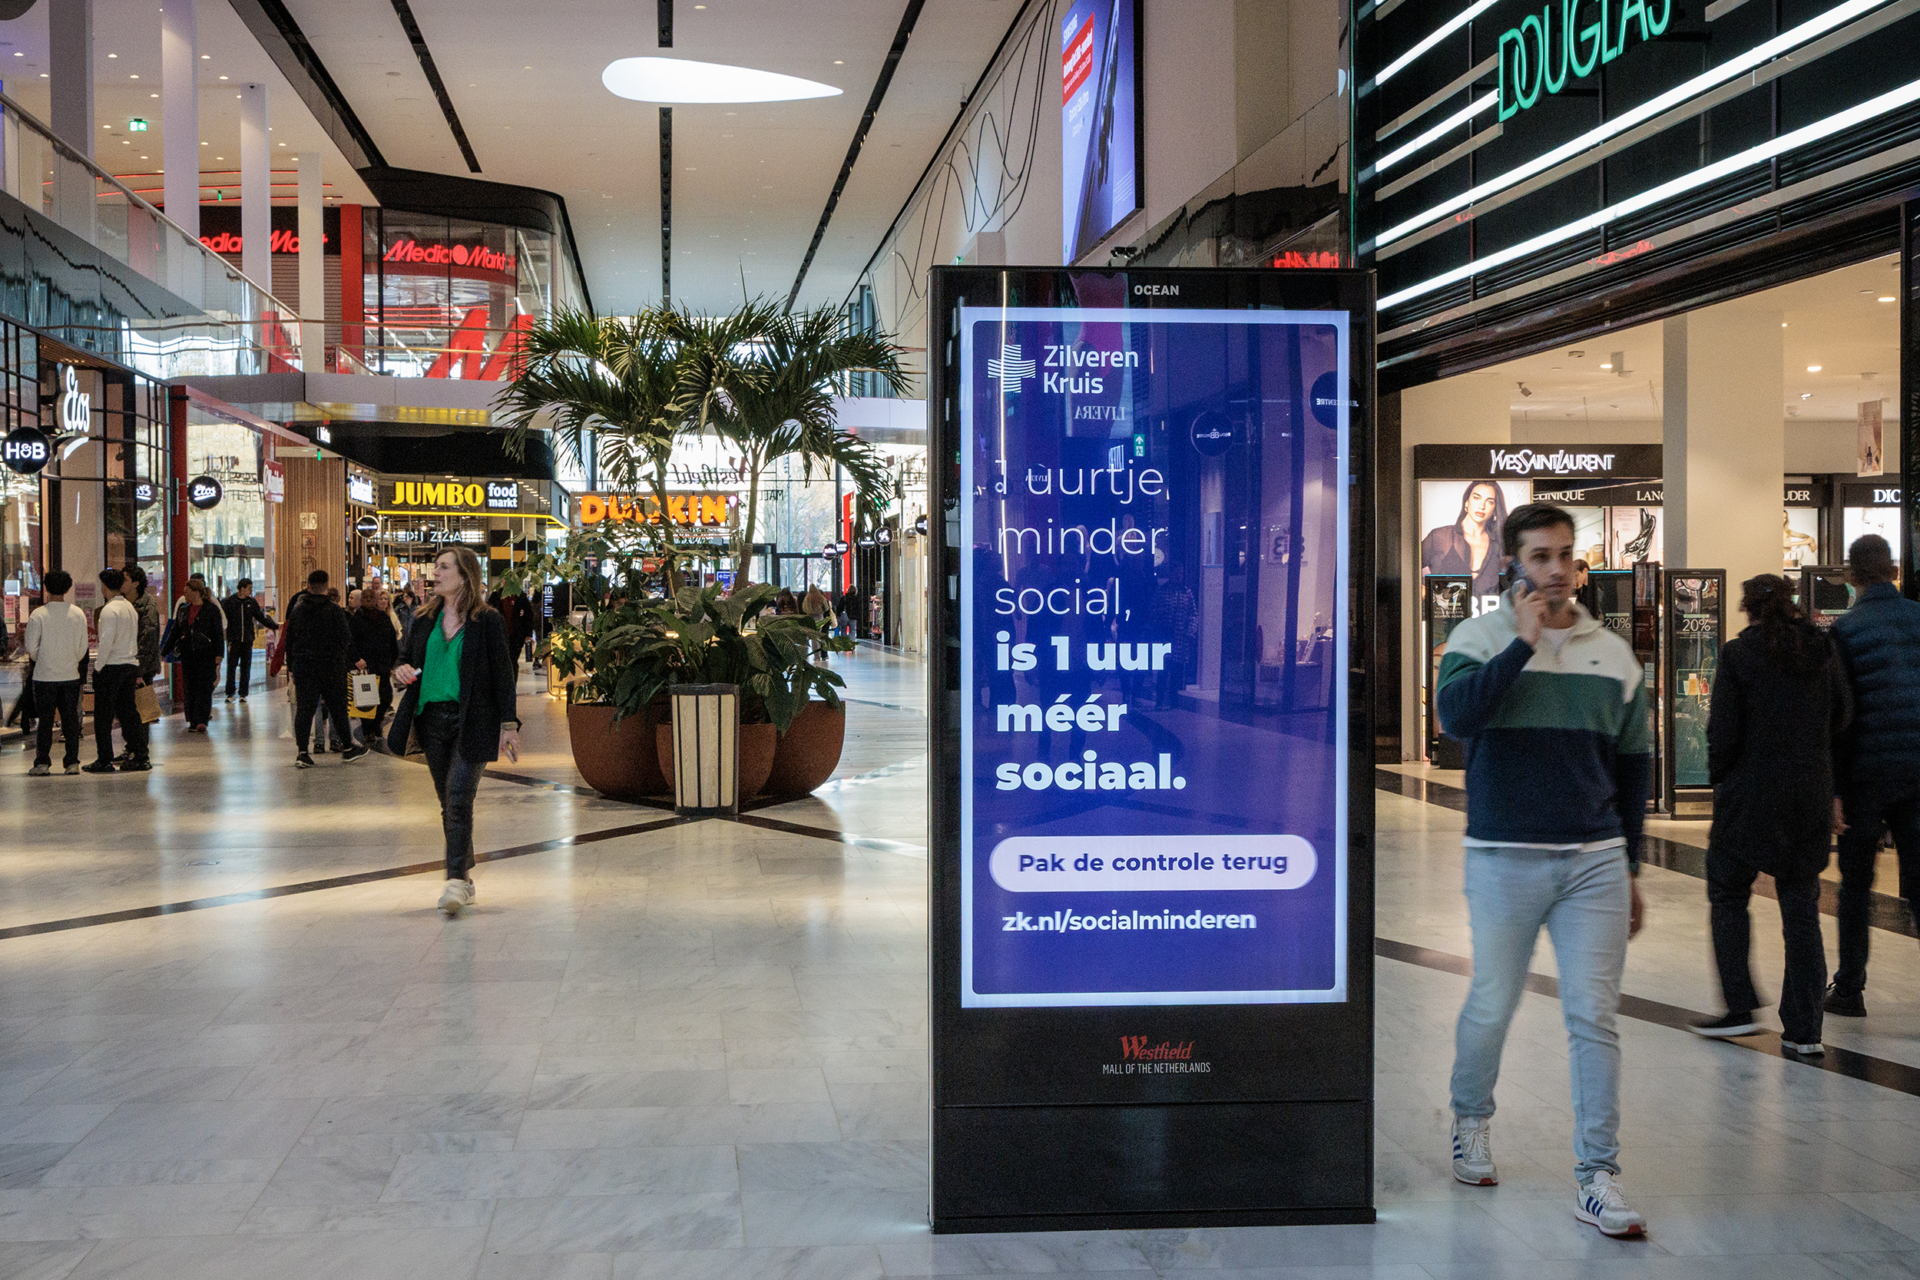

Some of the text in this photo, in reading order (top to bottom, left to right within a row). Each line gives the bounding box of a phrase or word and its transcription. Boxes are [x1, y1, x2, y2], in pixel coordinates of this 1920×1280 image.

[198, 232, 243, 253] edia
[383, 240, 507, 270] Media Markt
[1133, 284, 1180, 296] OCEAN
[1043, 344, 1139, 368] Zilveren
[1043, 372, 1104, 394] Kruis
[63, 365, 91, 433] Etos
[5, 441, 46, 460] H&B
[391, 481, 485, 507] JUMBO
[488, 482, 518, 498] food
[488, 497, 518, 509] markt
[1783, 490, 1811, 501] UDER
[1873, 489, 1901, 503] DIO
[998, 517, 1165, 555] minder
[994, 577, 1132, 622] social,
[1604, 617, 1632, 629] 20%
[1682, 618, 1711, 632] 20%
[996, 630, 1172, 671] is 1 uur
[996, 693, 1127, 732] méér
[995, 750, 1187, 790] sociaal.
[1018, 852, 1289, 874] Pak de controle terug
[1002, 909, 1257, 933] zk.nl/socialminderen
[1119, 1034, 1196, 1061] Westfield
[1102, 1062, 1211, 1075] MALL OF THE NETHERLANDS
